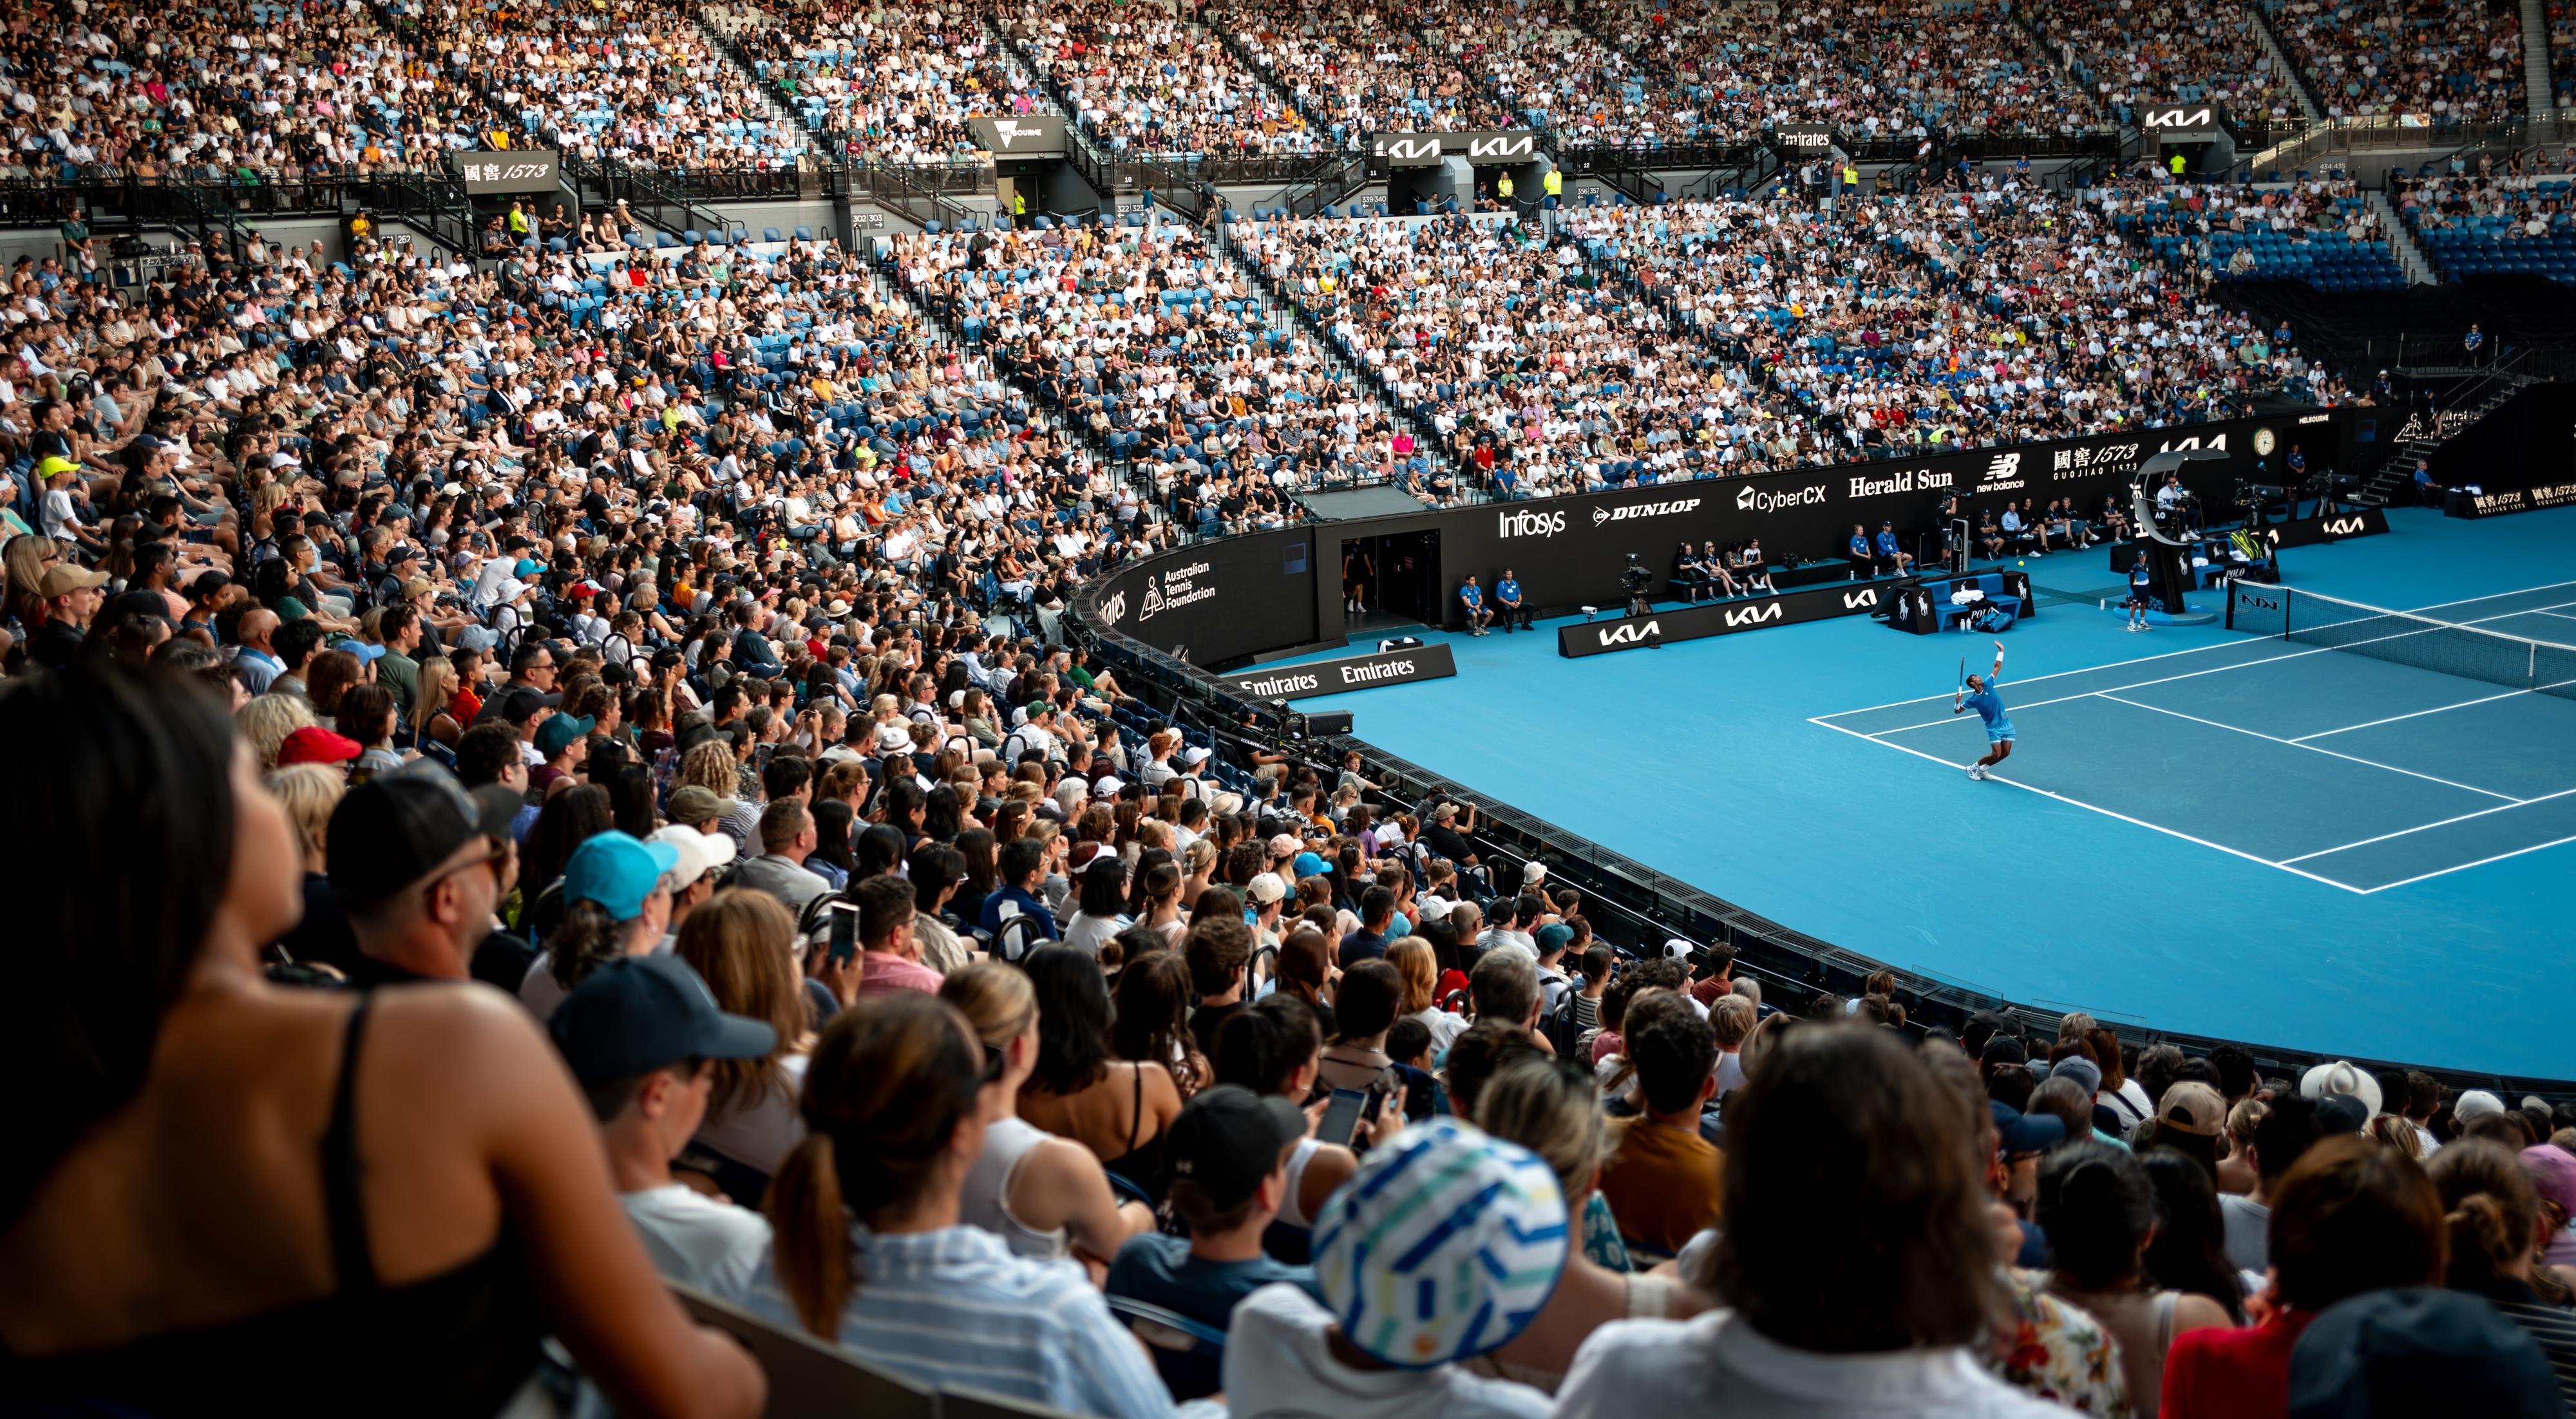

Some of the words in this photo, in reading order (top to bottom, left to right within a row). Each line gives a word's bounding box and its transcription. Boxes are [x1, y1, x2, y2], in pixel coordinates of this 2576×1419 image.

[1471, 136, 1533, 156] KIA
[398, 235, 411, 244] 262
[2299, 414, 2329, 424] MELBOURNE
[2054, 467, 2103, 480] GUOJIAO
[2112, 462, 2137, 474] 1573
[1849, 471, 1913, 498] Herald
[1918, 469, 1953, 489] Sun
[1977, 484, 1993, 493] new
[1994, 479, 2025, 492] balance
[1611, 498, 1700, 520] DUNLOP
[1757, 485, 1826, 513] CyberCX
[2129, 483, 2149, 538] Her
[1499, 510, 1566, 538] Infosys
[1165, 563, 1209, 583] Australian
[2226, 567, 2245, 578] POLO
[1165, 578, 1193, 596] Tennis
[1099, 590, 1126, 626] irates
[1166, 587, 1215, 610] Foundation
[1843, 588, 1878, 609] KI
[1725, 603, 1783, 627] KIA
[1341, 660, 1415, 684] Emirates
